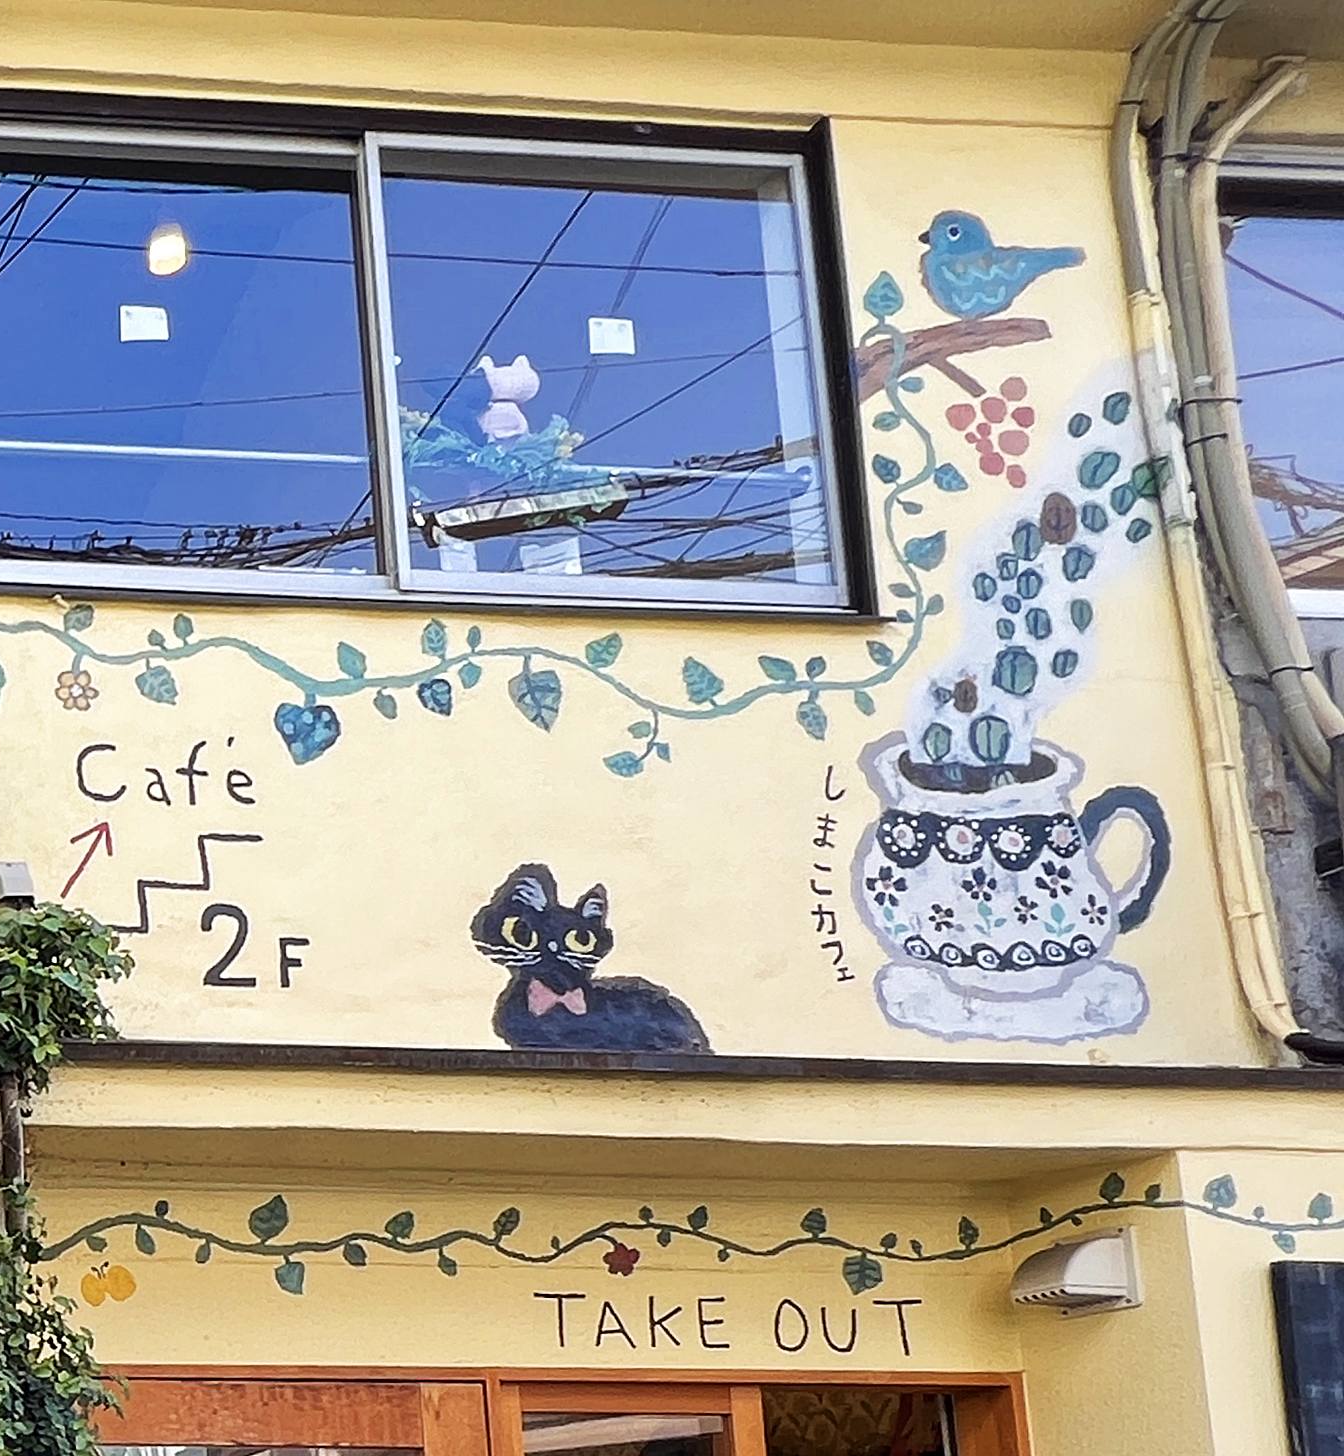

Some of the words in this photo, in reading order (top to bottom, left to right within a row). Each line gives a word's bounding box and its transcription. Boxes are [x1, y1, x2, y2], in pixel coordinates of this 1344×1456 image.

[76, 735, 258, 808] Café
[810, 764, 857, 984] しまこカフェ
[200, 905, 311, 990] 2F
[532, 1290, 732, 1354] TAKE
[772, 1298, 924, 1359] OUT
